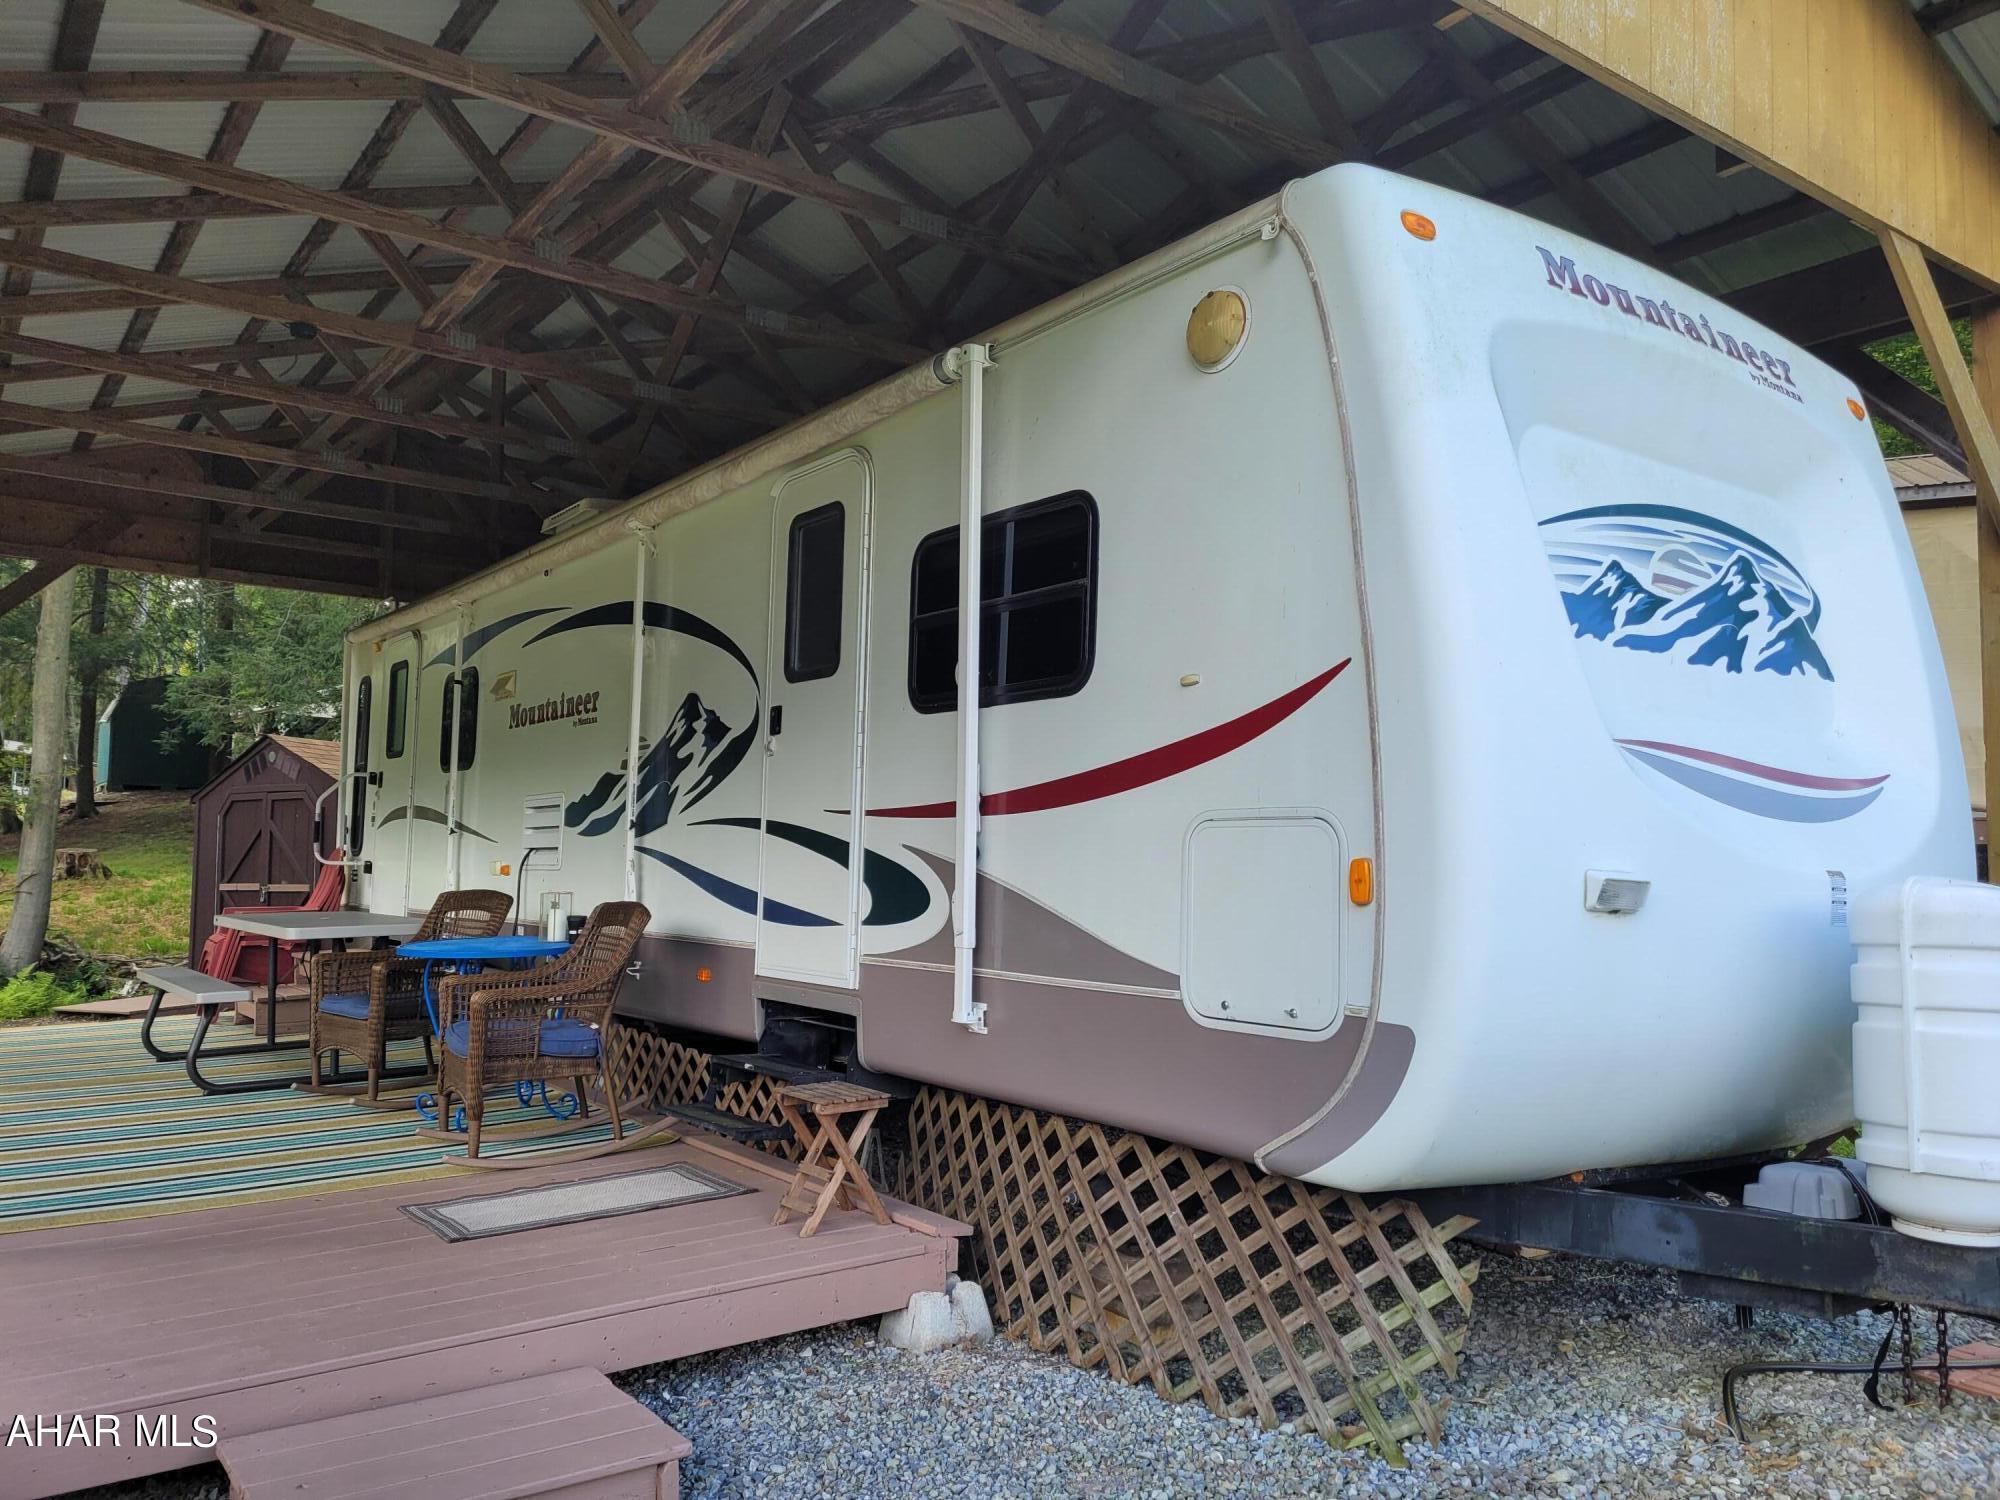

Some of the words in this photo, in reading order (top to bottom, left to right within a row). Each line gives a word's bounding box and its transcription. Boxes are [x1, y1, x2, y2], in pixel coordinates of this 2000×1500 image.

[1535, 245, 1796, 388] Mountaineer
[1759, 374, 1805, 404] Montana
[508, 691, 600, 729] Mountaineer
[577, 716, 598, 726] Montana
